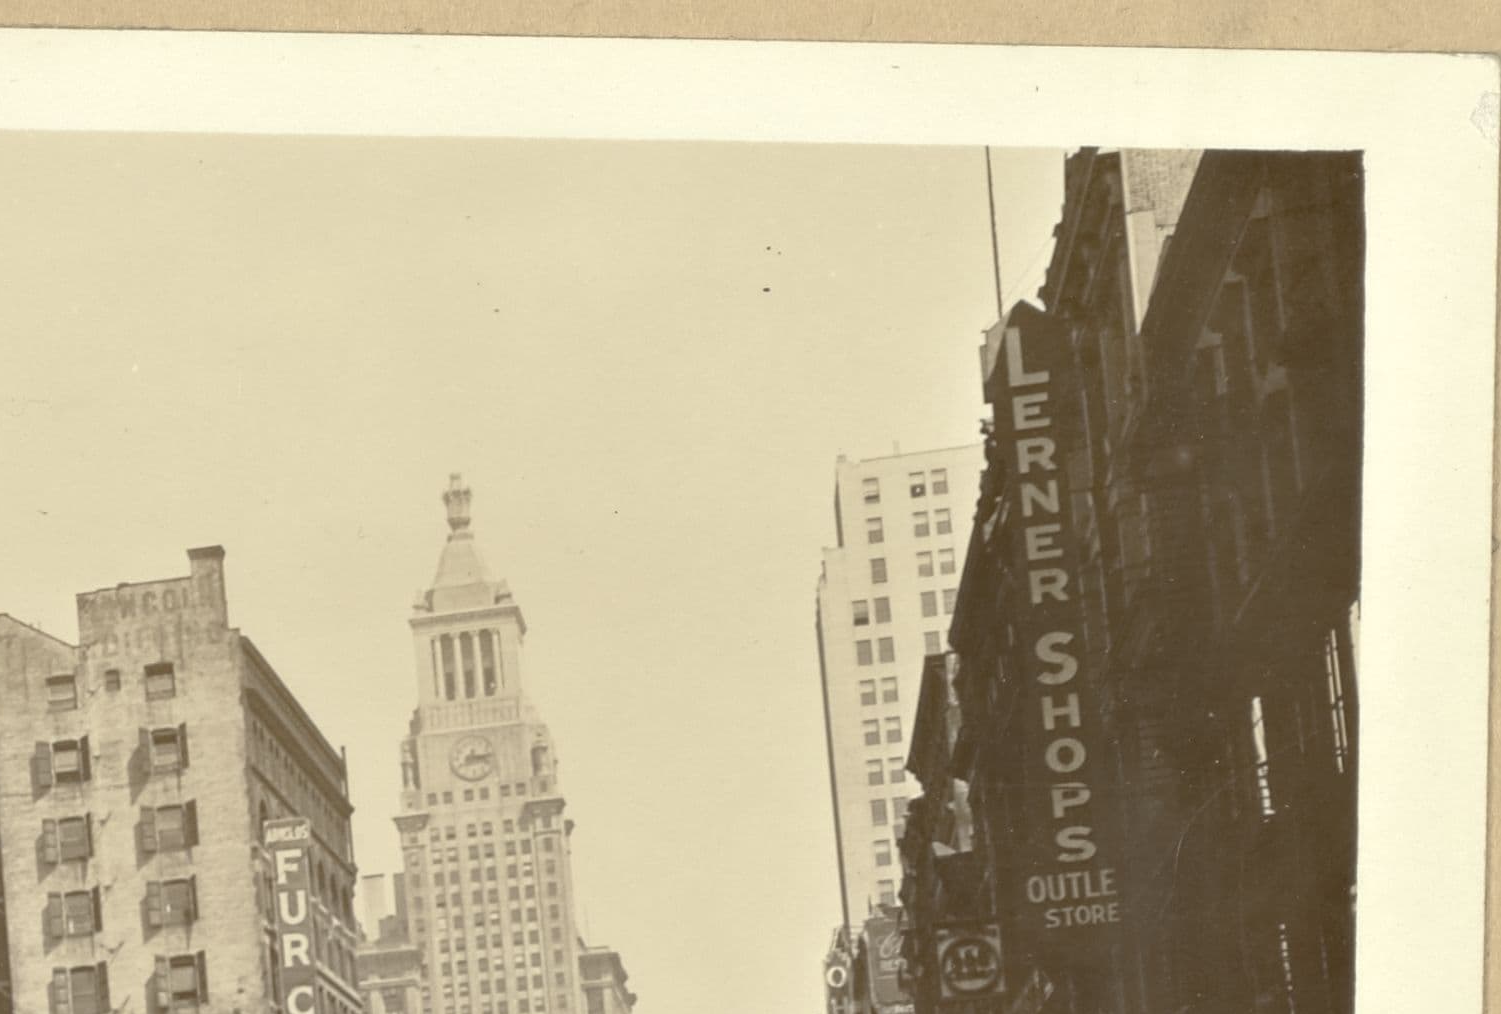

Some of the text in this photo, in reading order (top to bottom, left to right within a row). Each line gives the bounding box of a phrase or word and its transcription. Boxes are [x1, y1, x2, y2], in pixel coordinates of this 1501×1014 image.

[1007, 326, 1098, 863] LERNER SHOPS
[275, 848, 312, 968] FUR
[1045, 903, 1121, 929] STORE
